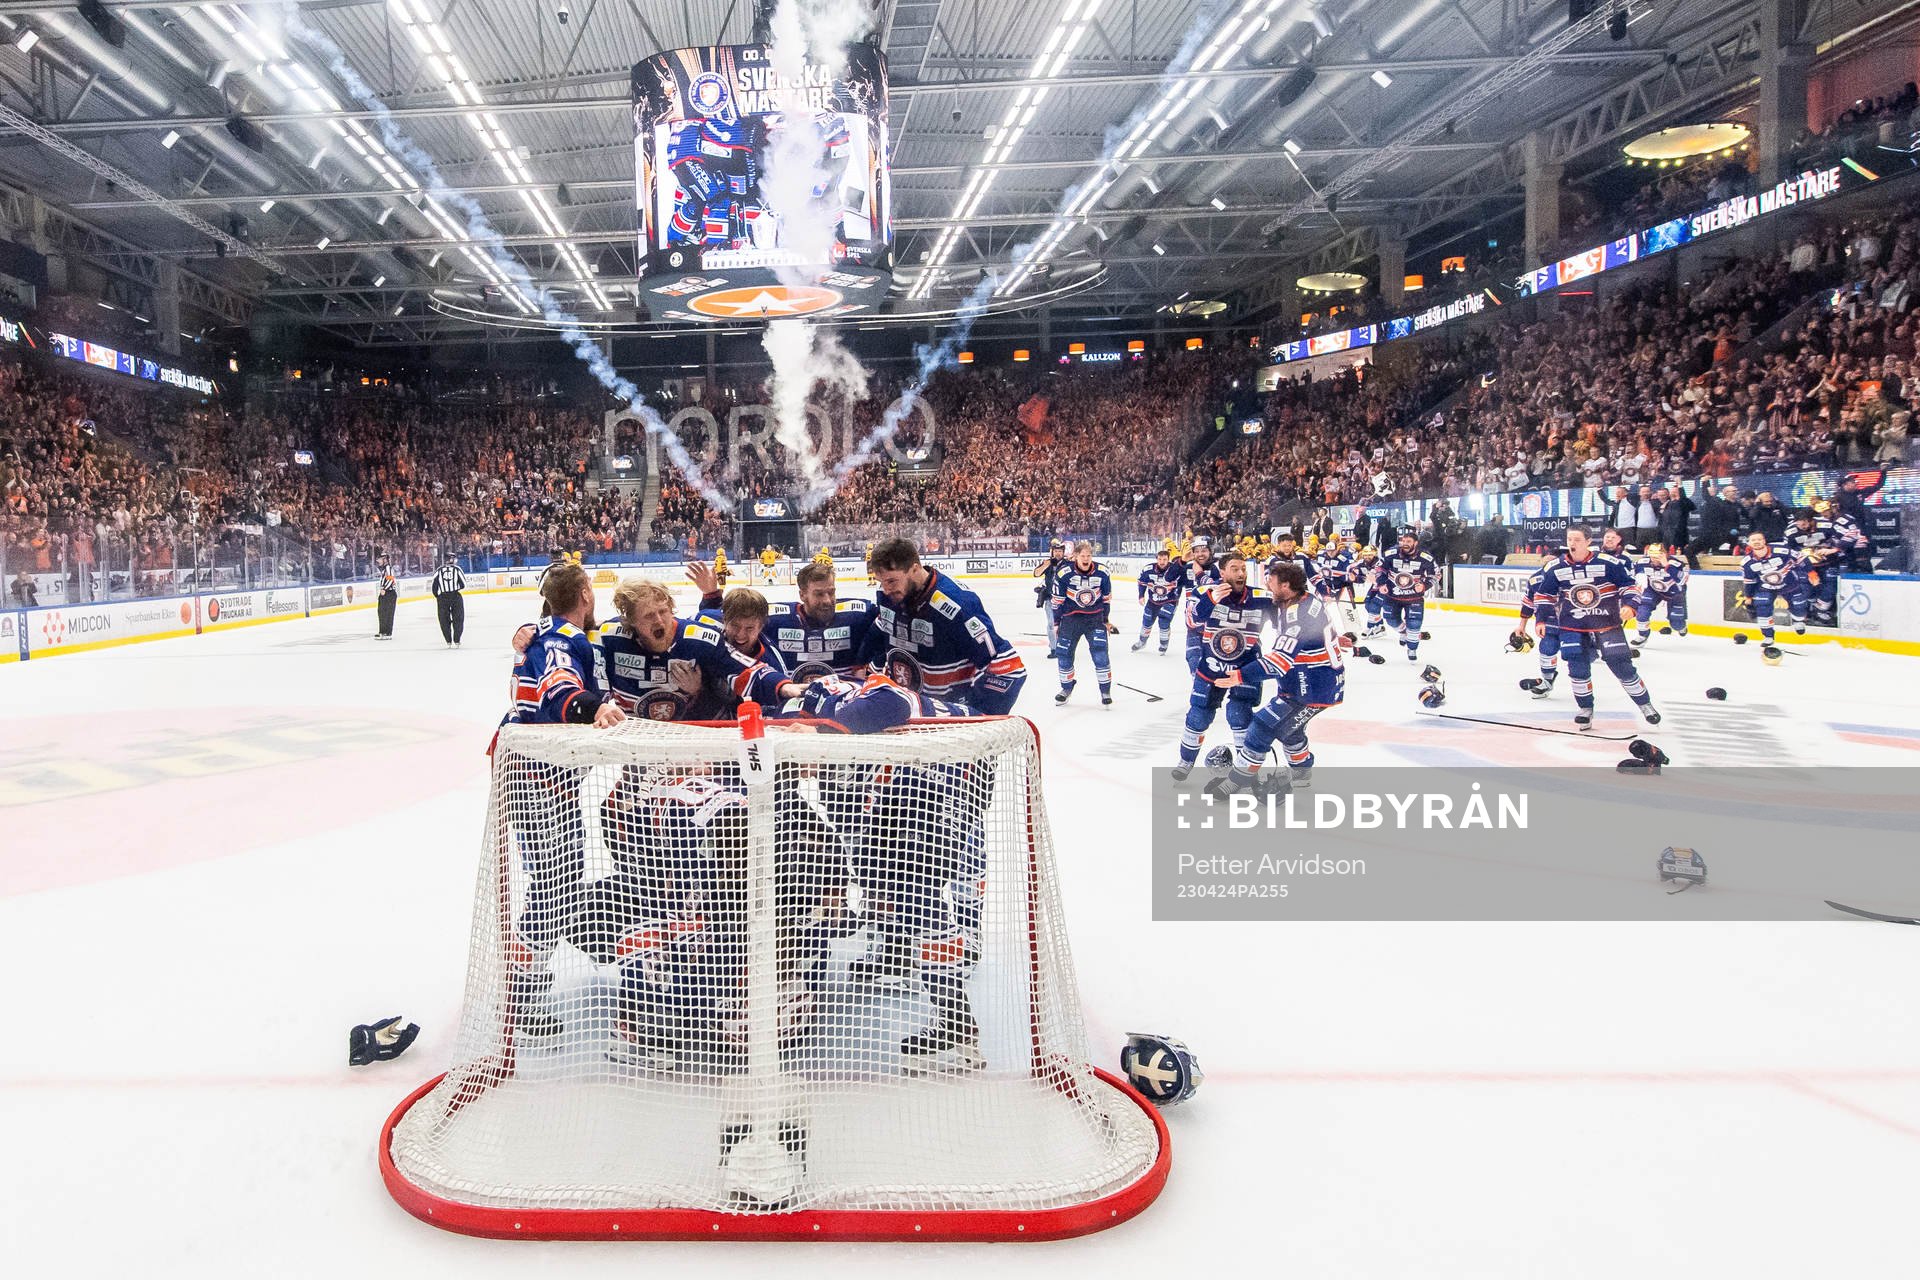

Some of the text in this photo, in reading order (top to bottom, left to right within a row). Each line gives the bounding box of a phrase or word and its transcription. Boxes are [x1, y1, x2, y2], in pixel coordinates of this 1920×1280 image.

[1692, 195, 1759, 237] SVENSKA
[510, 576, 523, 587] put
[775, 606, 788, 614] put
[851, 602, 864, 610] put
[940, 602, 957, 616] put
[68, 614, 111, 634] MIDCON
[702, 630, 718, 640] put
[780, 630, 802, 639] wilo
[1275, 635, 1298, 654] 60
[616, 655, 642, 667] wilo
